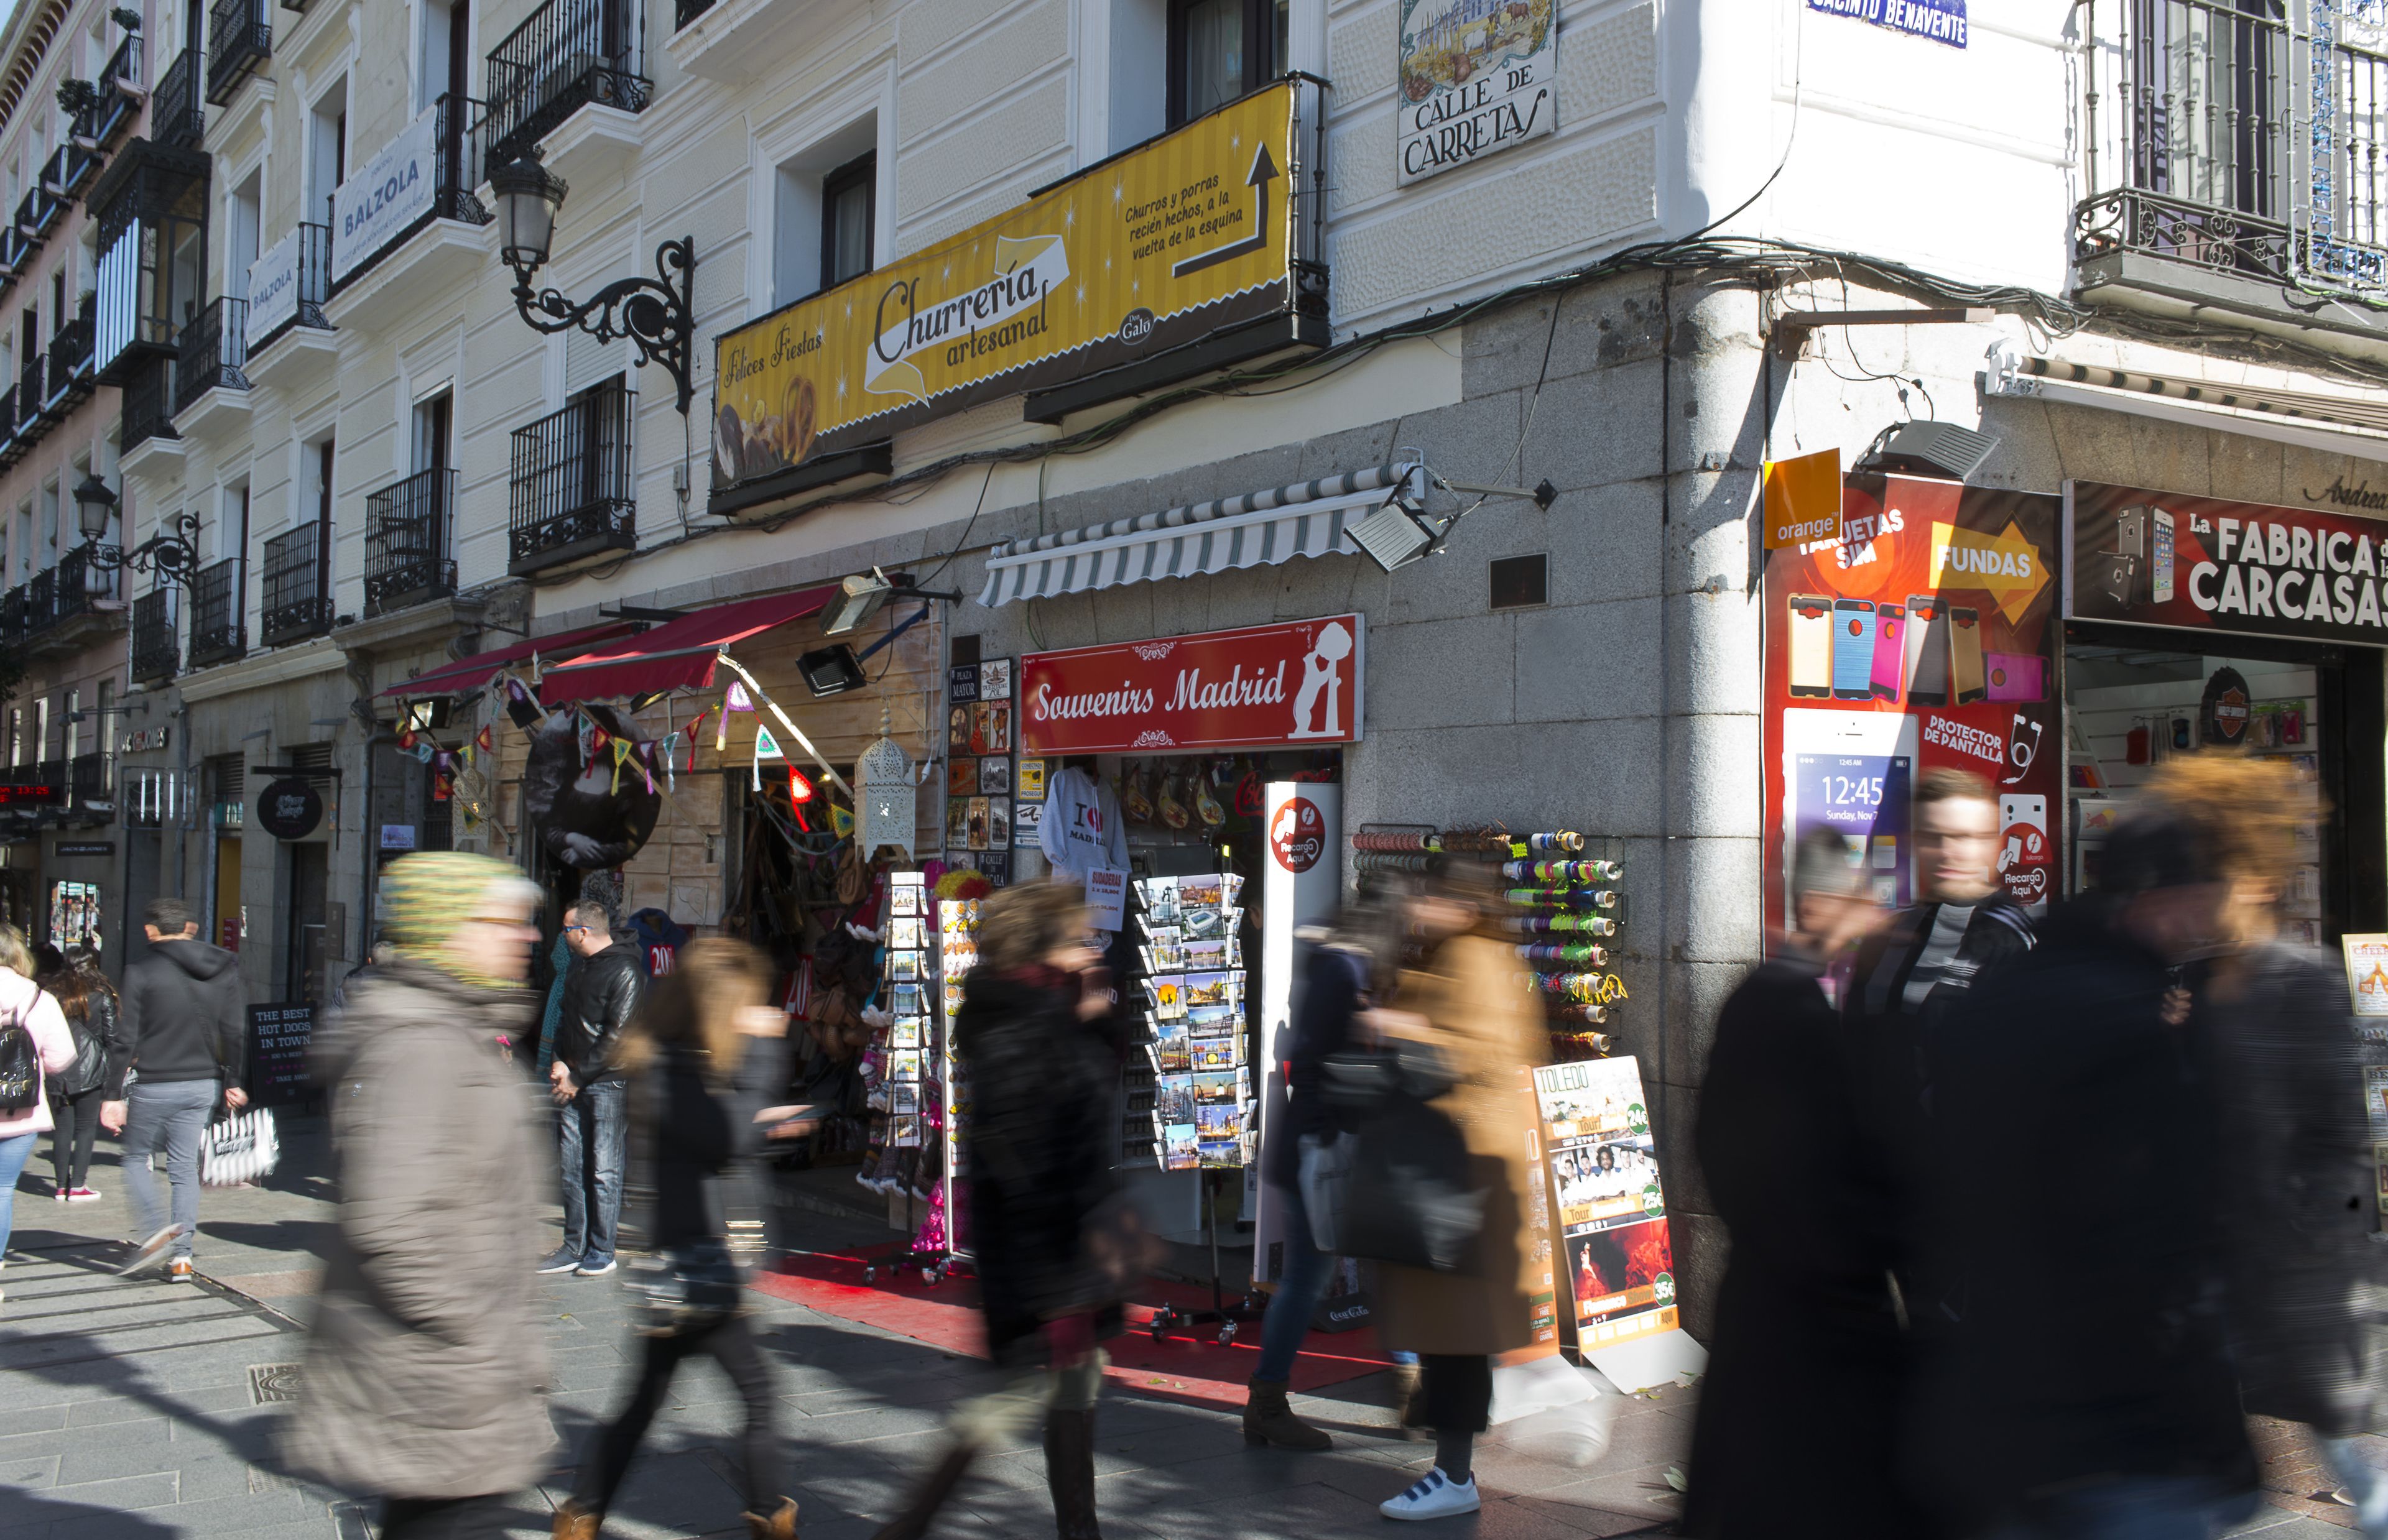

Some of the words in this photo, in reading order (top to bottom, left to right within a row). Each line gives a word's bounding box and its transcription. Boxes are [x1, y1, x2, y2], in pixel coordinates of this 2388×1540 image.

[1884, 1, 1966, 44] BENAVENTE
[1415, 78, 1492, 131] CALLE
[1507, 65, 1534, 92] DE
[1405, 88, 1547, 175] CARRETAS
[345, 159, 419, 238] BALZOLA
[1126, 195, 1167, 223] Churros
[1170, 193, 1177, 208] y
[1181, 175, 1219, 206] porras
[1130, 216, 1162, 242] recién
[1165, 202, 1204, 228] hechos,
[1208, 198, 1215, 211] a
[1219, 190, 1229, 208] la
[1133, 236, 1165, 260] vuelta
[1169, 228, 1182, 246] de
[1185, 223, 1195, 241] la
[1200, 208, 1243, 236] esquina
[254, 268, 292, 310] BALZOLA
[874, 259, 1037, 362] Churrería
[946, 279, 1048, 367] artesanal
[1129, 313, 1140, 323] Don
[723, 344, 764, 388] Felices
[770, 323, 822, 367] Fiestas
[1778, 516, 1834, 540] orange
[1836, 540, 1877, 569] SIM
[2190, 513, 2211, 535] La
[2219, 517, 2376, 577] FABRICA
[1937, 544, 2031, 578] FUNDAS
[2189, 561, 2388, 629] CARCASA
[957, 670, 972, 680] PLAZA
[953, 683, 975, 697] MAYOR
[1034, 680, 1154, 722] Souvenirs
[1164, 659, 1286, 711] Madrid
[1924, 727, 1939, 742] DE
[1941, 731, 2004, 765] PANTALLA
[1930, 714, 2001, 749] PROTECTOR
[1822, 776, 1882, 806] 12:45
[1074, 802, 1087, 828] I
[1826, 810, 1856, 822] Sunday,
[1858, 811, 1871, 820] Nov
[986, 855, 1002, 864] CALLE
[1280, 842, 1313, 854] Recarga
[1092, 871, 1121, 887] SUDADERAS
[2005, 874, 2040, 885] Recarga
[2011, 885, 2030, 898] Aquí
[256, 1011, 279, 1021] THE
[283, 1008, 310, 1019] BEST
[258, 1024, 280, 1035] HOT
[284, 1022, 311, 1033] DOGS
[261, 1038, 274, 1048] IN
[277, 1035, 311, 1047] TOWN
[1537, 1065, 1589, 1094] TOLEDO
[1628, 1110, 1648, 1127] 24€
[1643, 1191, 1664, 1207] 25€
[1569, 1209, 1590, 1222] Tour
[1627, 1290, 1651, 1304] Show
[1655, 1282, 1675, 1300] 35€
